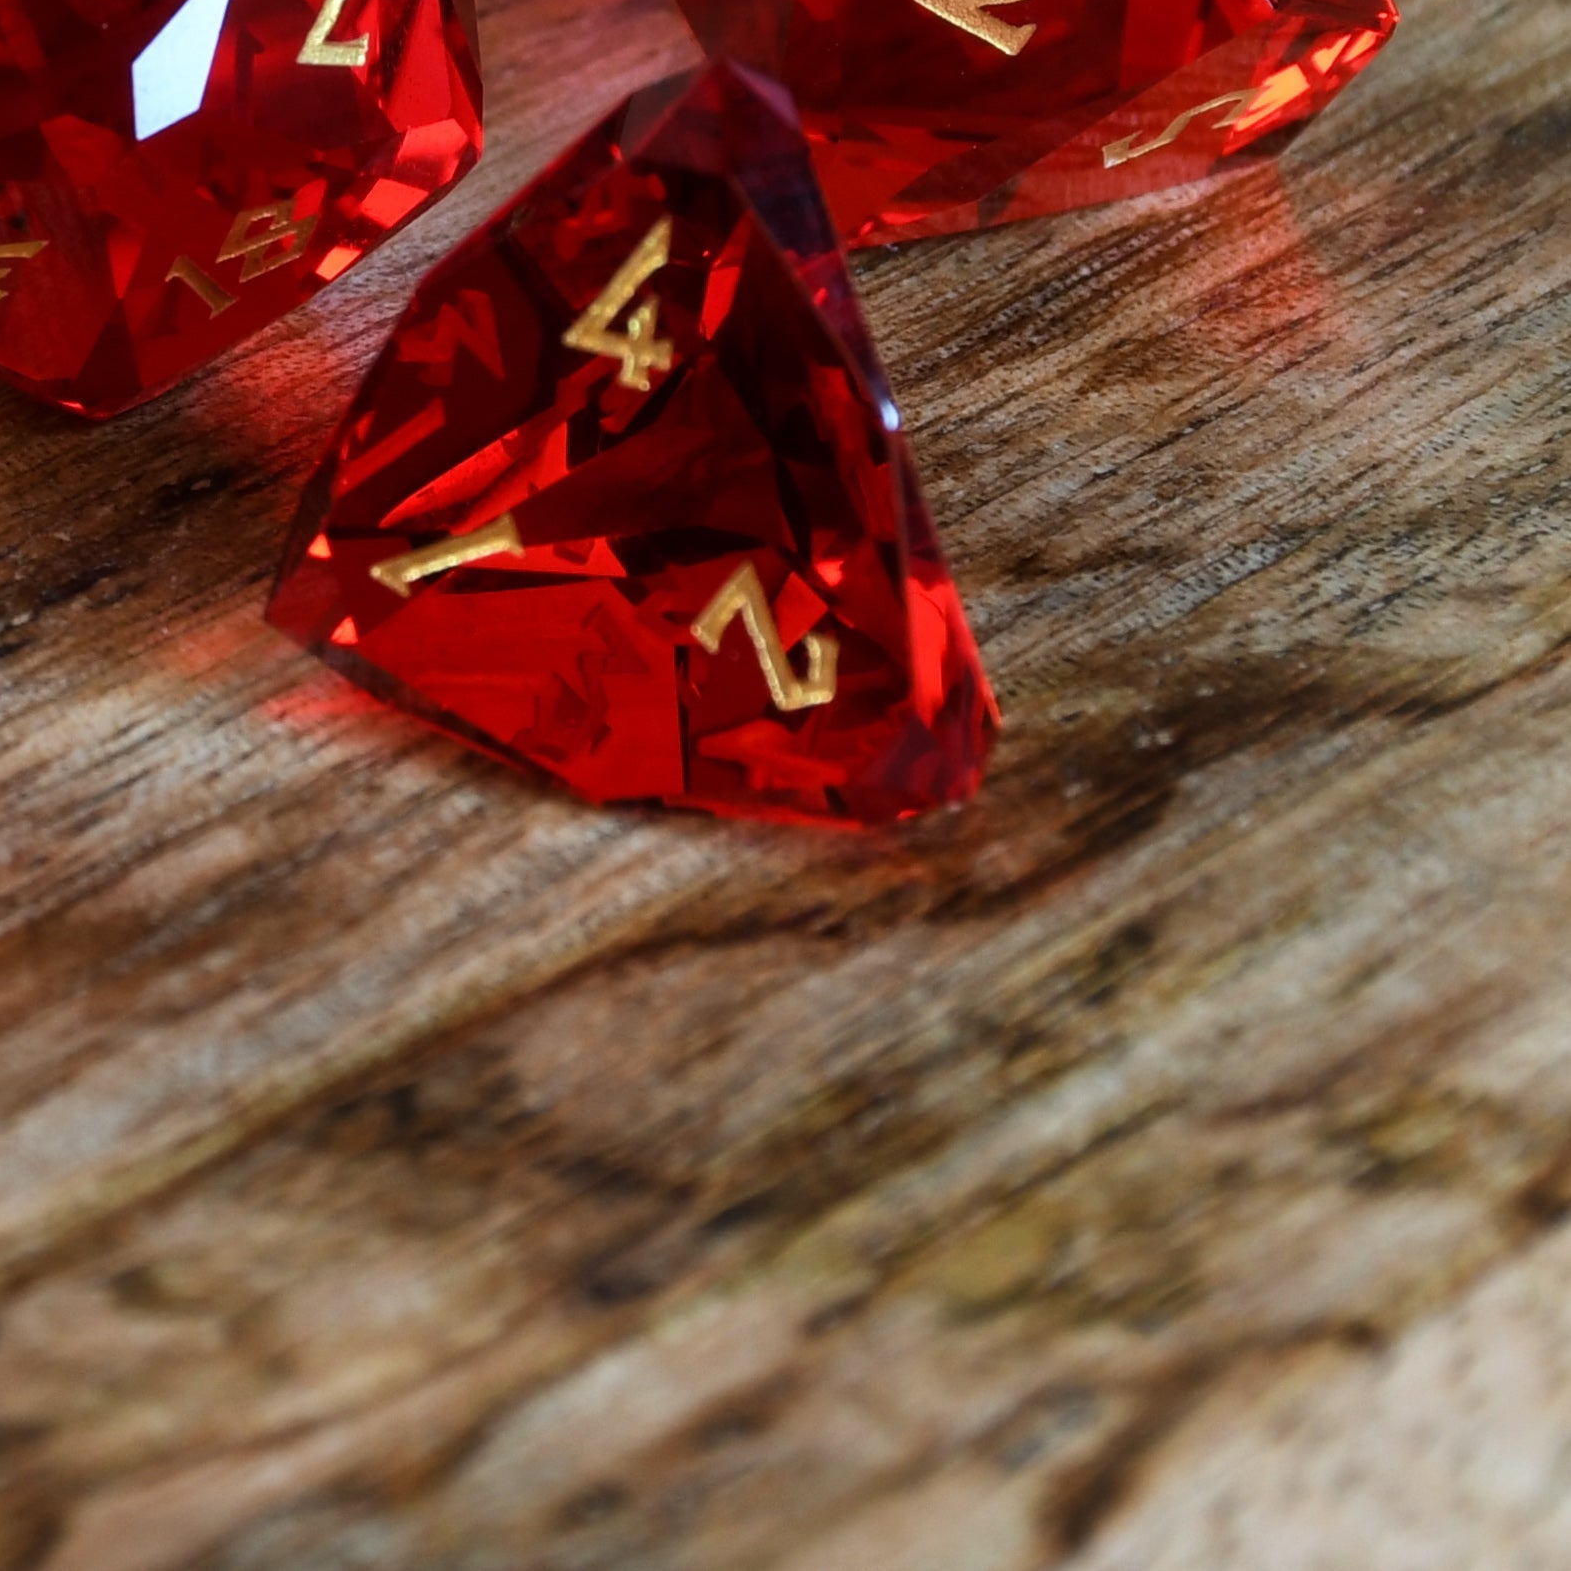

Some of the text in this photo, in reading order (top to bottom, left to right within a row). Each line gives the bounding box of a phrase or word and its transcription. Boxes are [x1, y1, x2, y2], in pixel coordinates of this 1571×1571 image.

[164, 198, 318, 318] 18
[563, 221, 672, 391] 4
[370, 515, 522, 595] 1
[693, 566, 838, 711] 2
